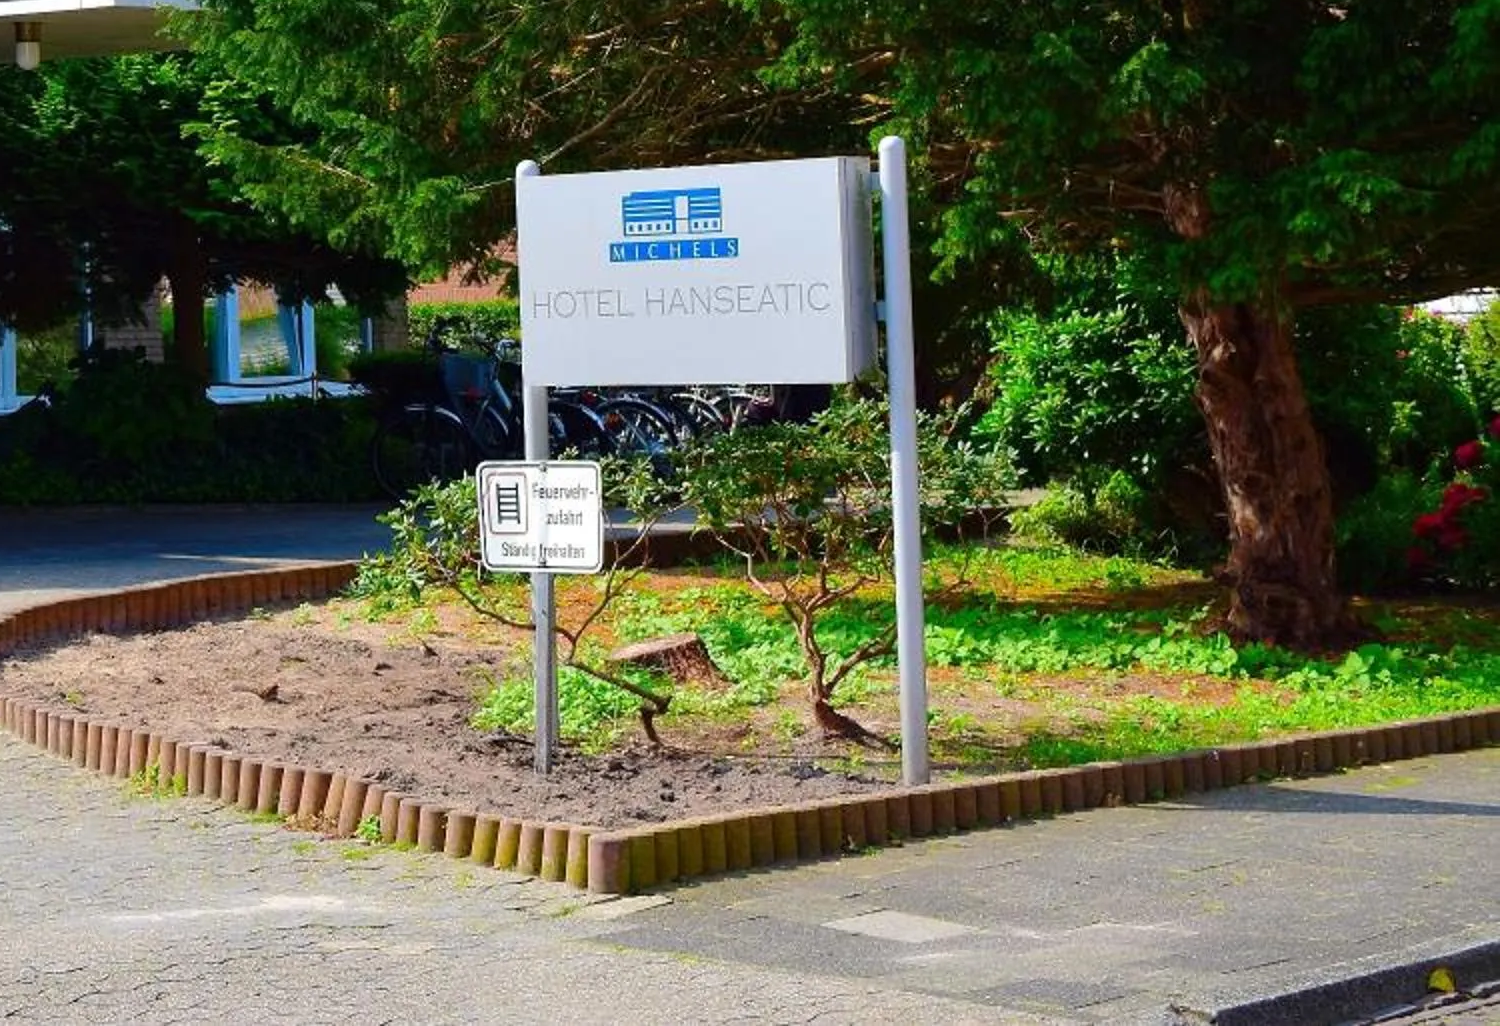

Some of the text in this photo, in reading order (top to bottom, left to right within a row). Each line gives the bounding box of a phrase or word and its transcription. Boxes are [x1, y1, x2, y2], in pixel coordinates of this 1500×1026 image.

[610, 239, 738, 262] MICHELS
[533, 283, 831, 319] HOTEL HANSEATIC
